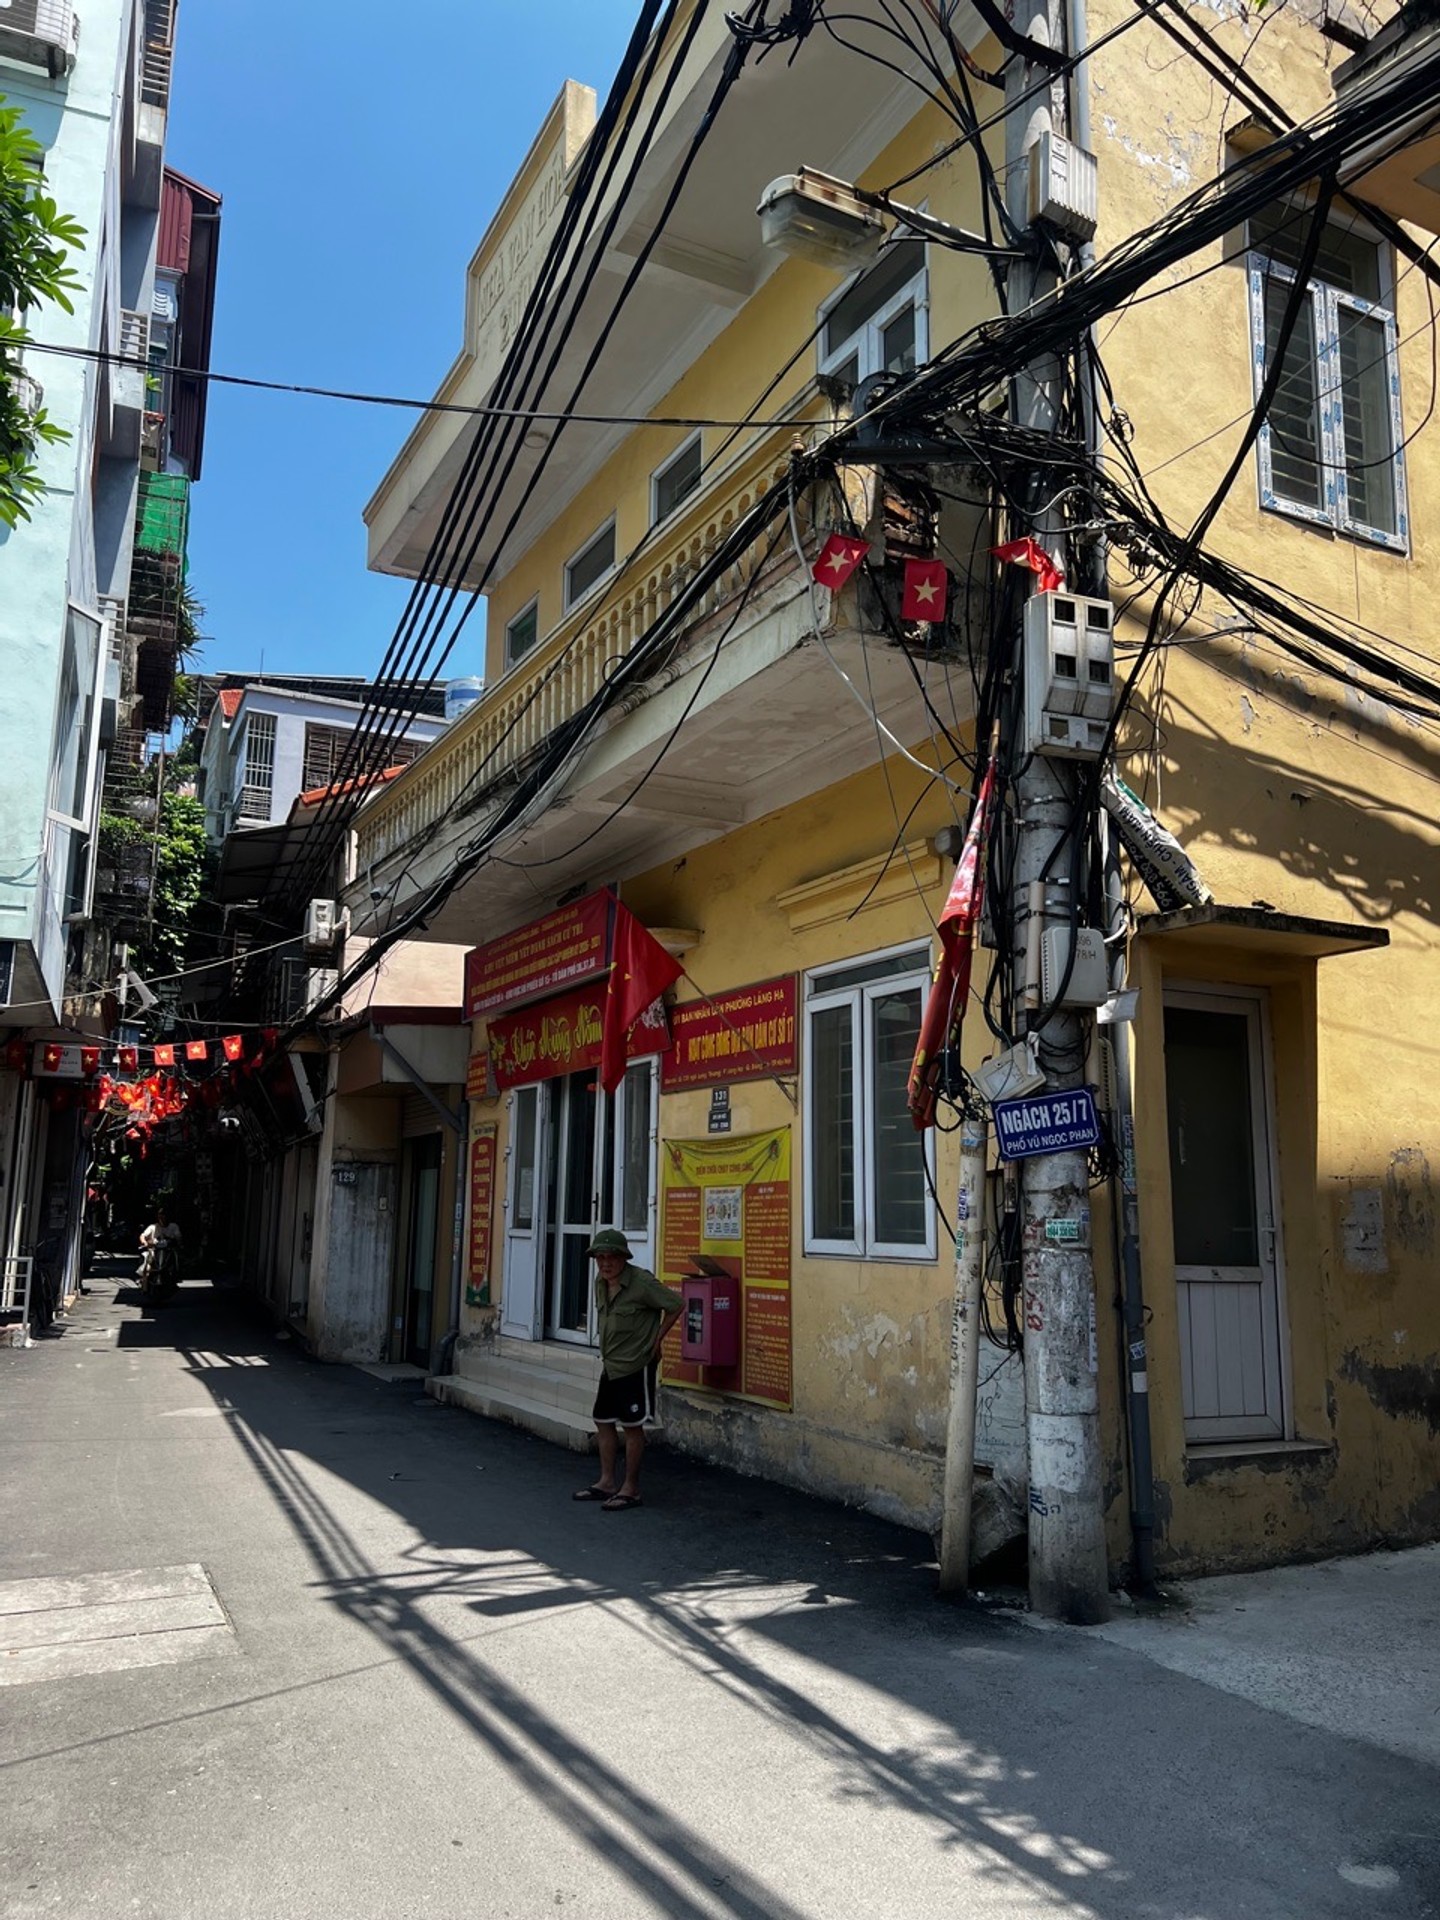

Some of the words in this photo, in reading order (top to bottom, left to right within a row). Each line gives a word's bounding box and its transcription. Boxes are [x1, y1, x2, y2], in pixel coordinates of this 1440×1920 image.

[681, 1011, 693, 1024] BAN
[694, 1006, 710, 1022] NHÂN
[725, 994, 752, 1013] PHƯỜNG
[753, 988, 773, 1008] LÁNG
[774, 988, 785, 1003] HẠ
[1000, 1103, 1051, 1135] NGÁCH
[1052, 1098, 1088, 1127] 25/7
[1006, 1135, 1027, 1152] PHỐ
[1027, 1136, 1041, 1148] VŨ
[1041, 1131, 1068, 1147] NGỌC
[1069, 1127, 1094, 1142] PHAN
[338, 1171, 356, 1182] 129
